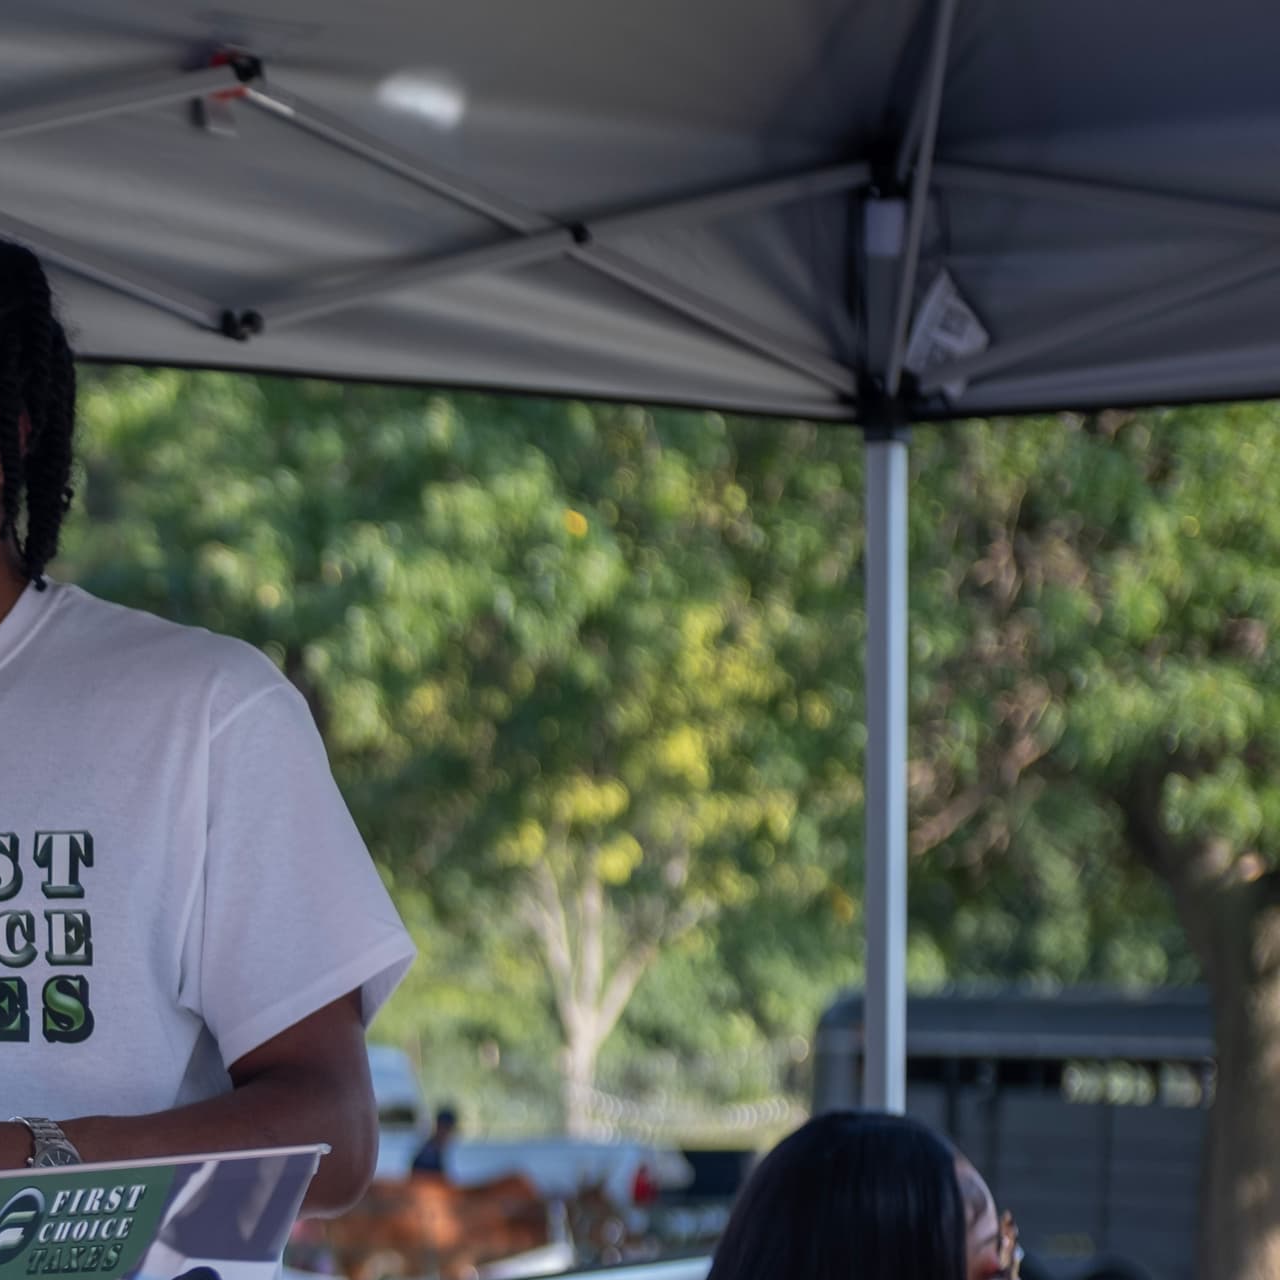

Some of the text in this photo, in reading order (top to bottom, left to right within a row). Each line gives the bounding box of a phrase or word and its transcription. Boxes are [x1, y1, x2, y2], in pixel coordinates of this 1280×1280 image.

[47, 1184, 147, 1218] FIRST
[38, 1216, 134, 1244] CHOICE
[25, 1243, 123, 1275] TAXES
